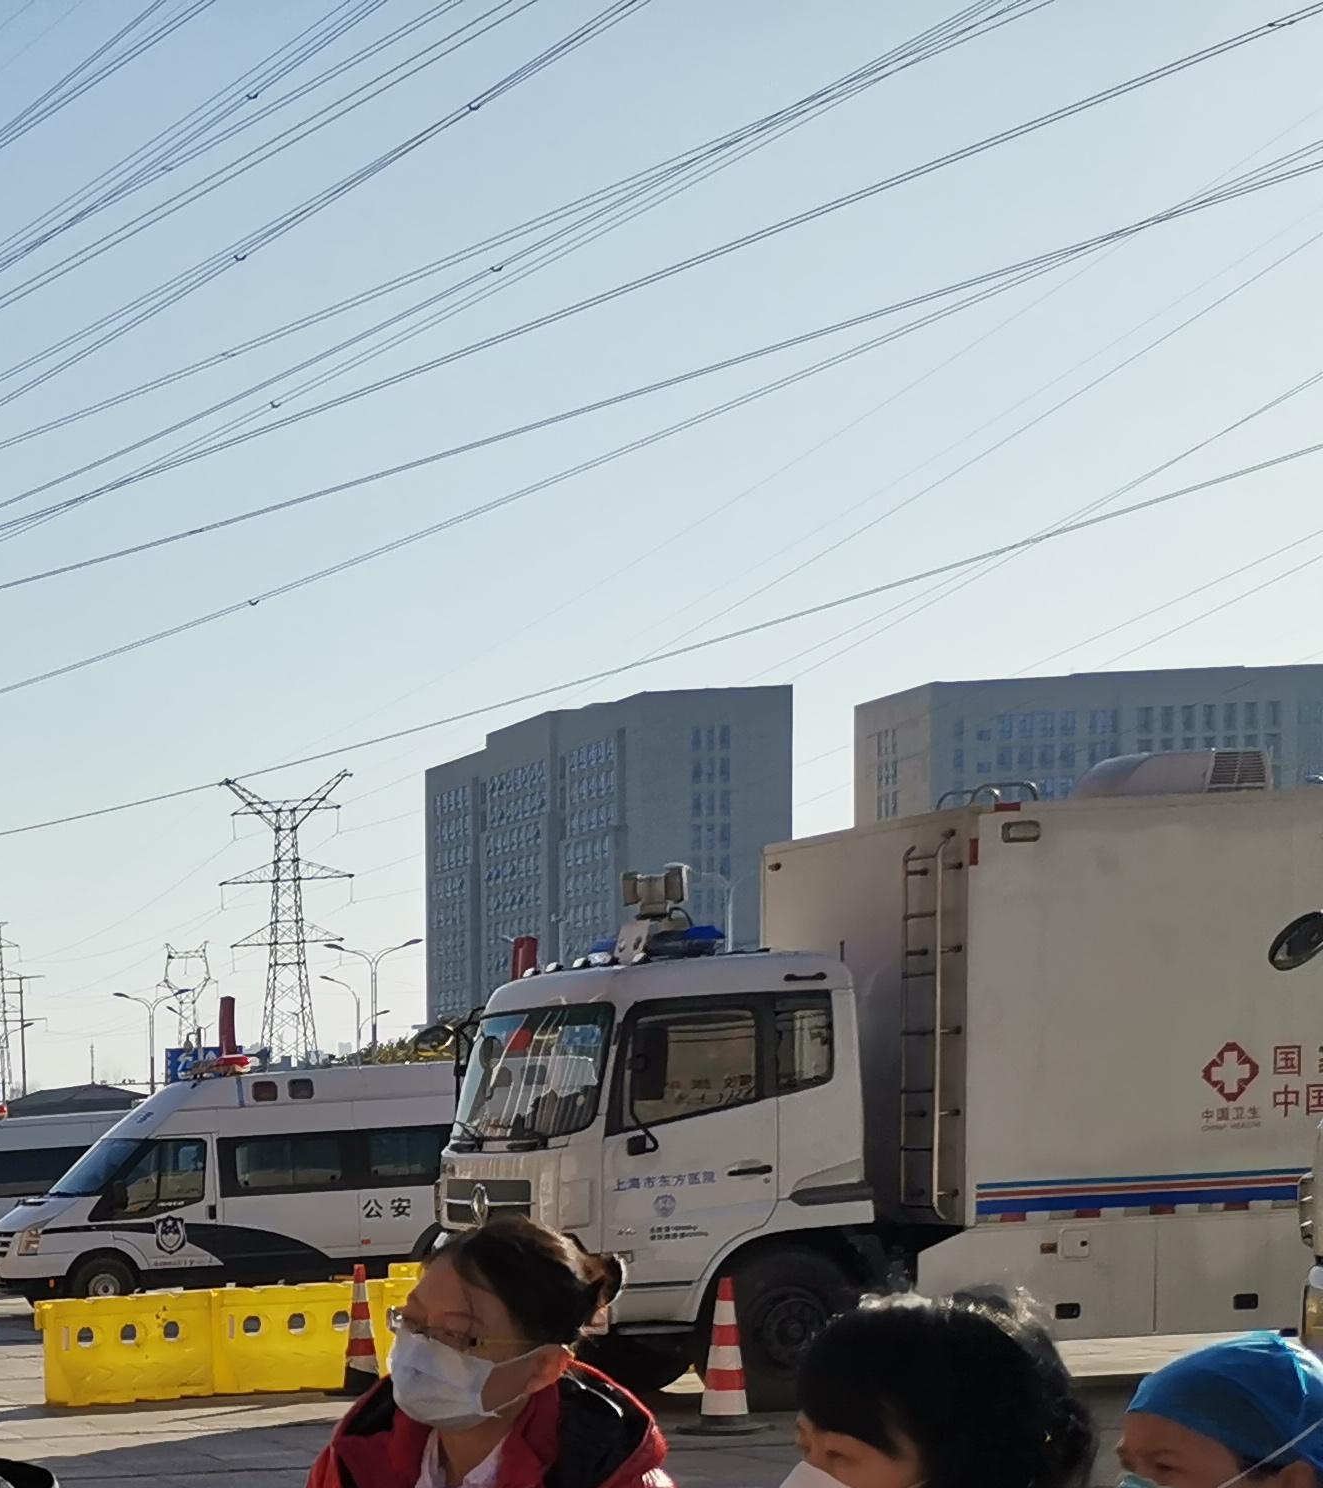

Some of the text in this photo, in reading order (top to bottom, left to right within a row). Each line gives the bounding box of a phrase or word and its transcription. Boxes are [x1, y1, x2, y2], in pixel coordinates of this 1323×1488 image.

[1201, 1106, 1260, 1122] 中国卫生
[613, 1171, 716, 1192] 上海市东方医院
[362, 1197, 411, 1219] 公安
